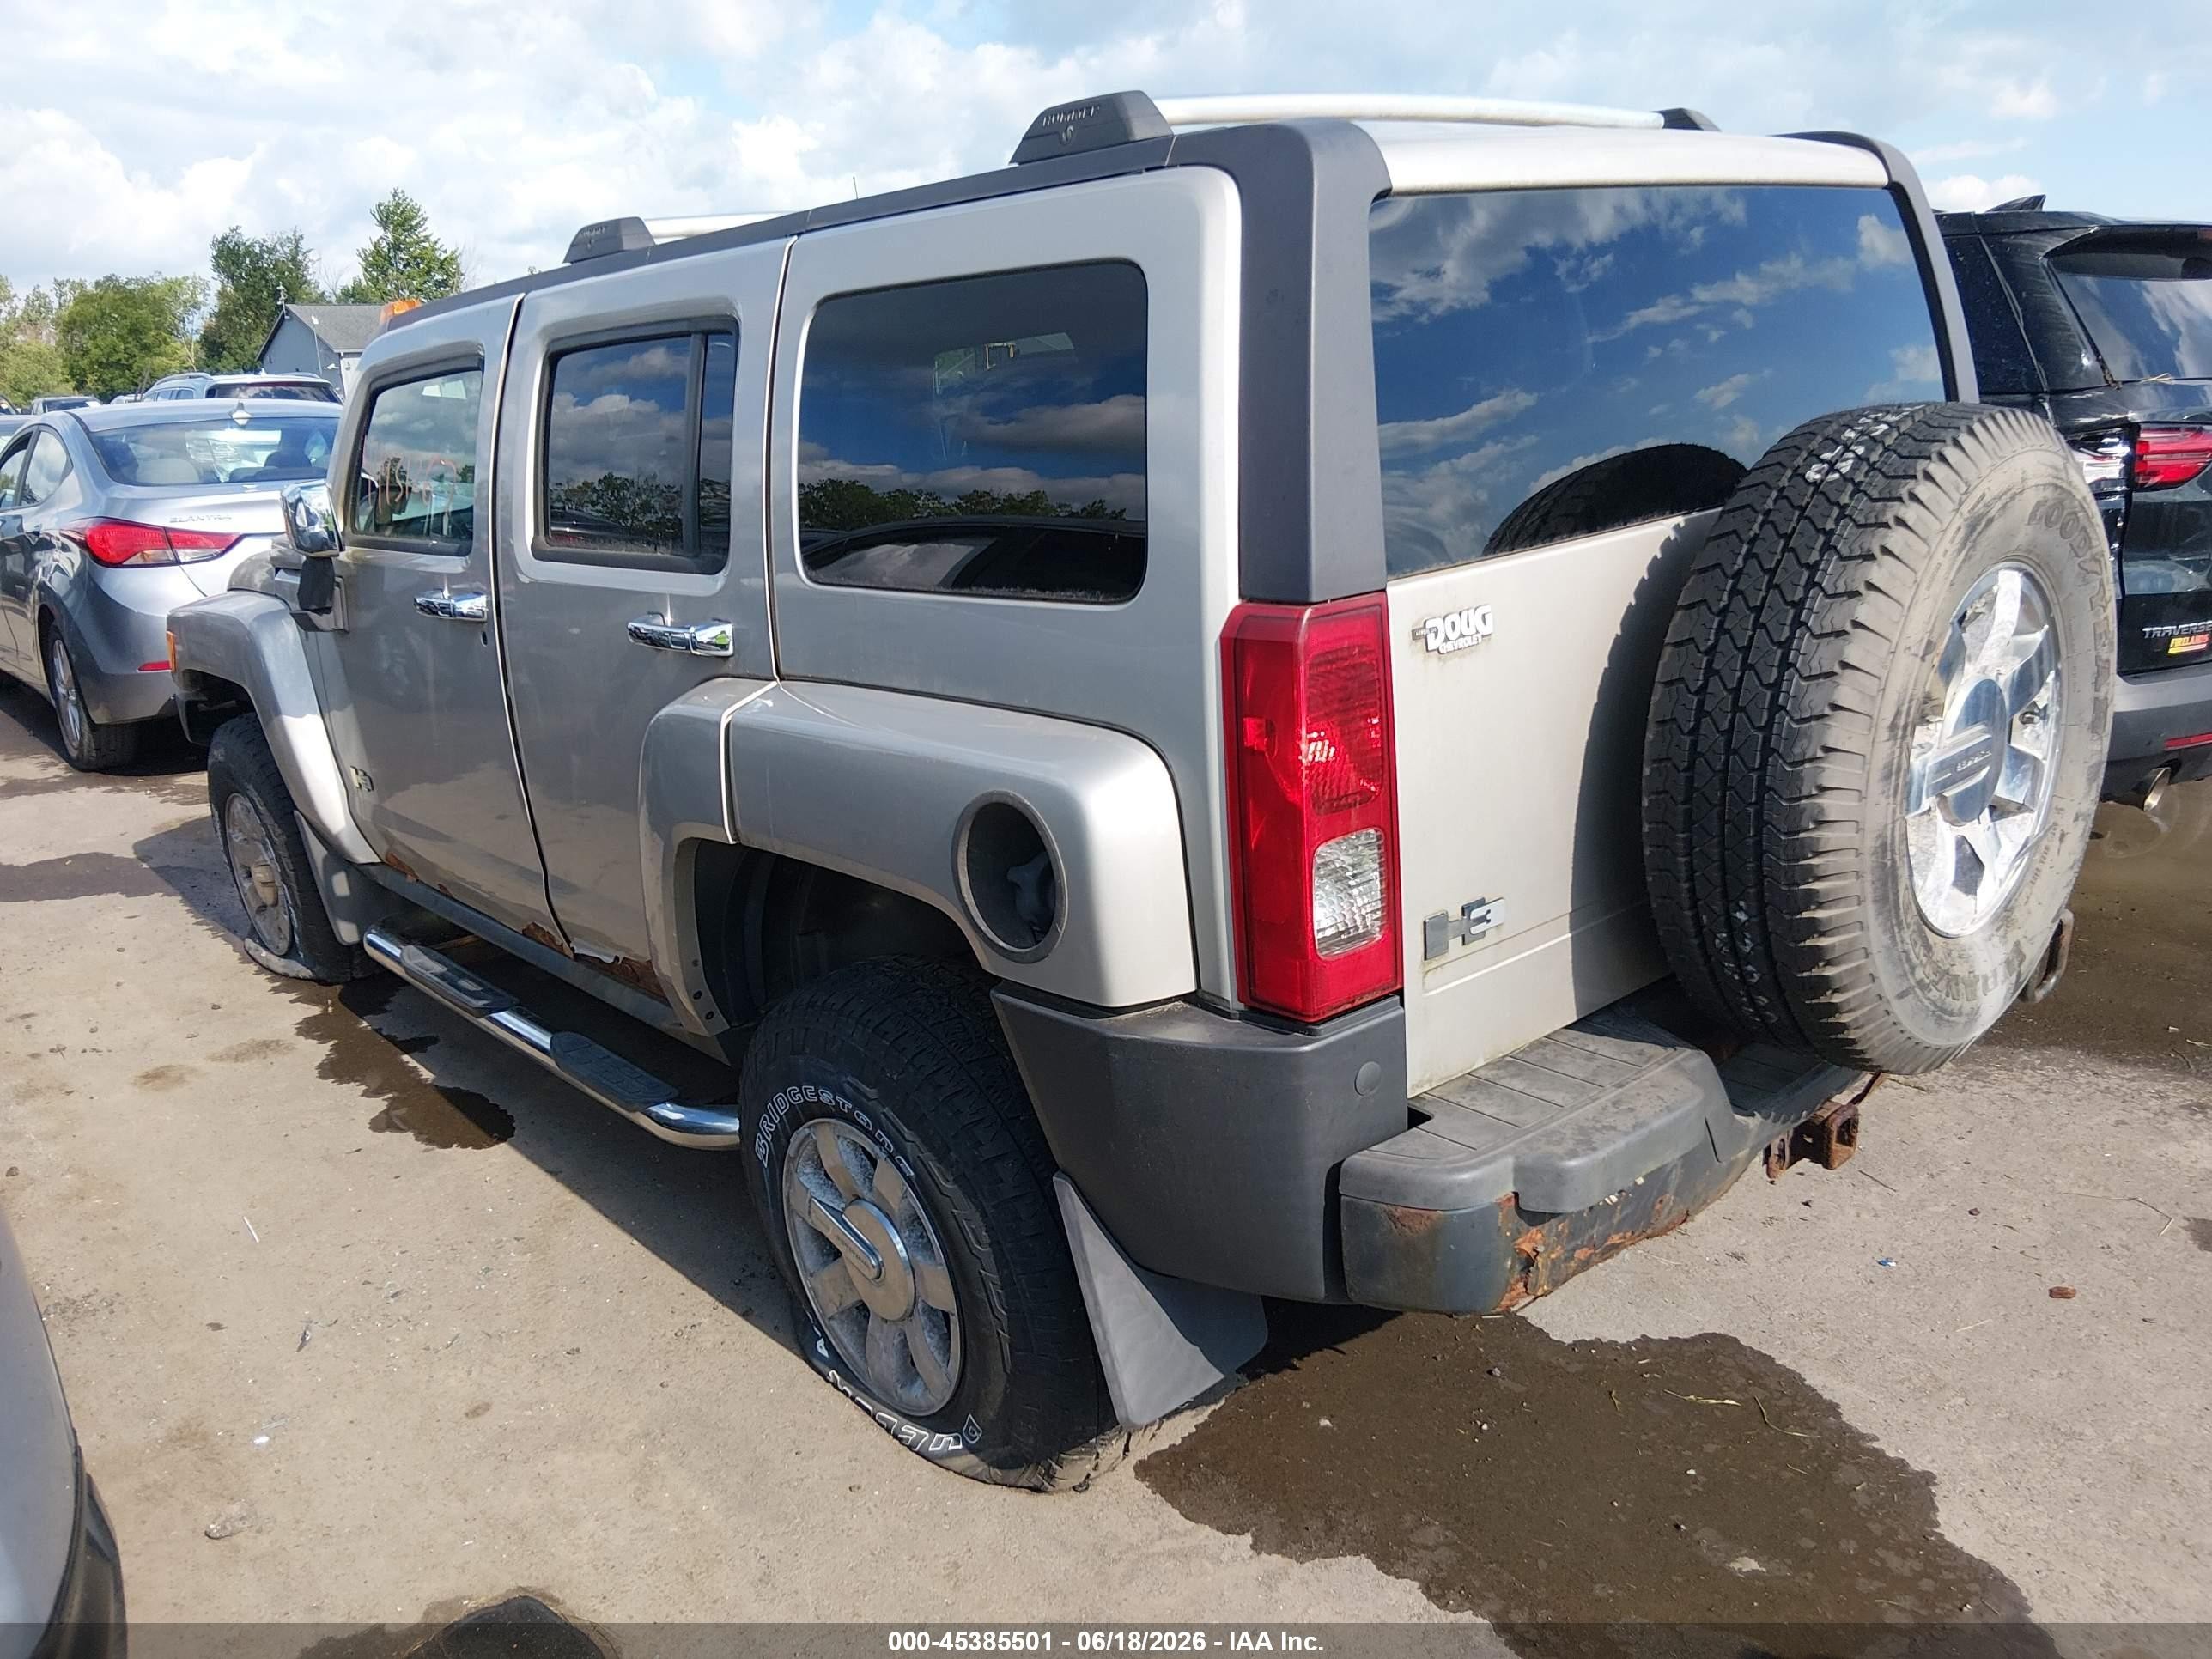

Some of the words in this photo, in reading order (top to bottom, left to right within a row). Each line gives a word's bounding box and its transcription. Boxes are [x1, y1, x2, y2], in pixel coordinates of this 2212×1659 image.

[1425, 604, 1493, 651] DOUG
[1437, 632, 1484, 654] CHEVROLET
[2142, 620, 2212, 639] TRAVERSE
[1423, 896, 1505, 961] H3
[755, 1085, 915, 1177] BRIDGESTONE
